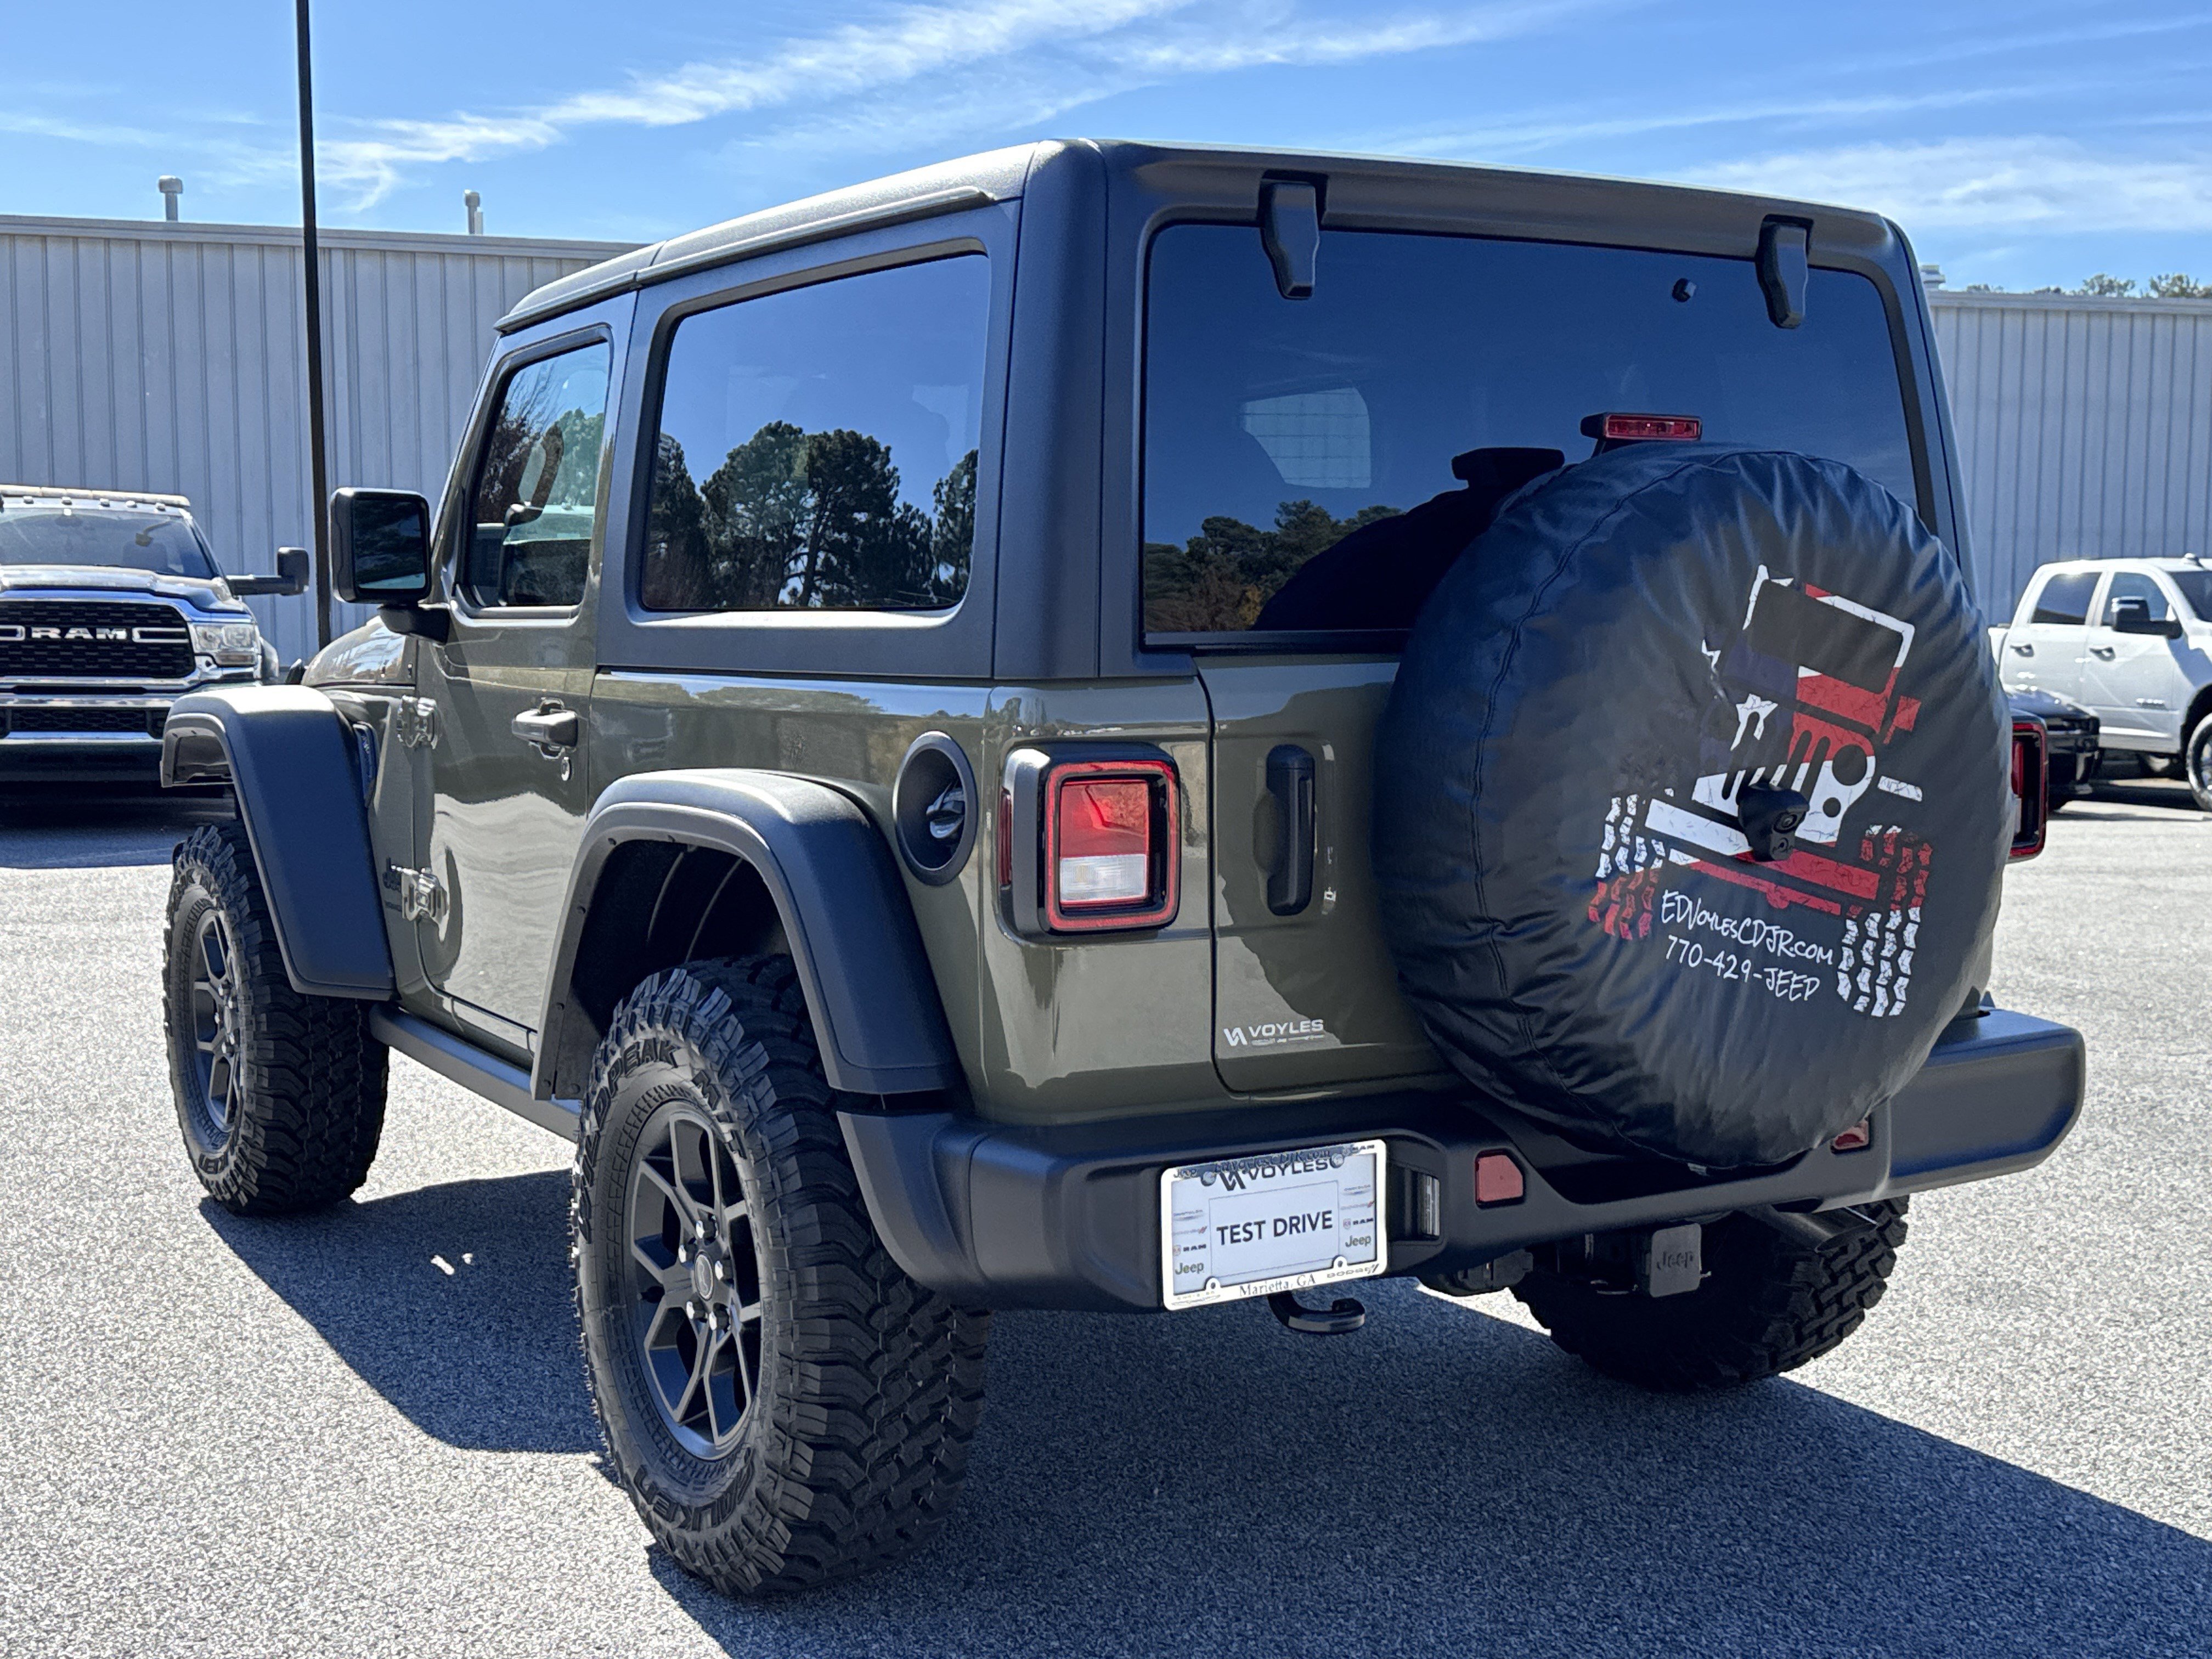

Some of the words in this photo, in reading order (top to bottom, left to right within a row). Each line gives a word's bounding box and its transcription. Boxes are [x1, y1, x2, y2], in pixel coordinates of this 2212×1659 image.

[31, 627, 127, 640] RAM
[1666, 934, 1820, 1002] 770-429-JEEP
[1248, 1019, 1324, 1038] VOYLES
[1248, 1158, 1328, 1181] VOYLES
[1216, 1220, 1266, 1245] TEST
[1273, 1210, 1333, 1238] DRIVE
[1345, 1235, 1372, 1247] Jeep
[1175, 1262, 1204, 1275] Jeep
[1656, 1251, 1693, 1271] Jeep
[1239, 1280, 1294, 1296] Marietta,
[1296, 1273, 1316, 1287] GA
